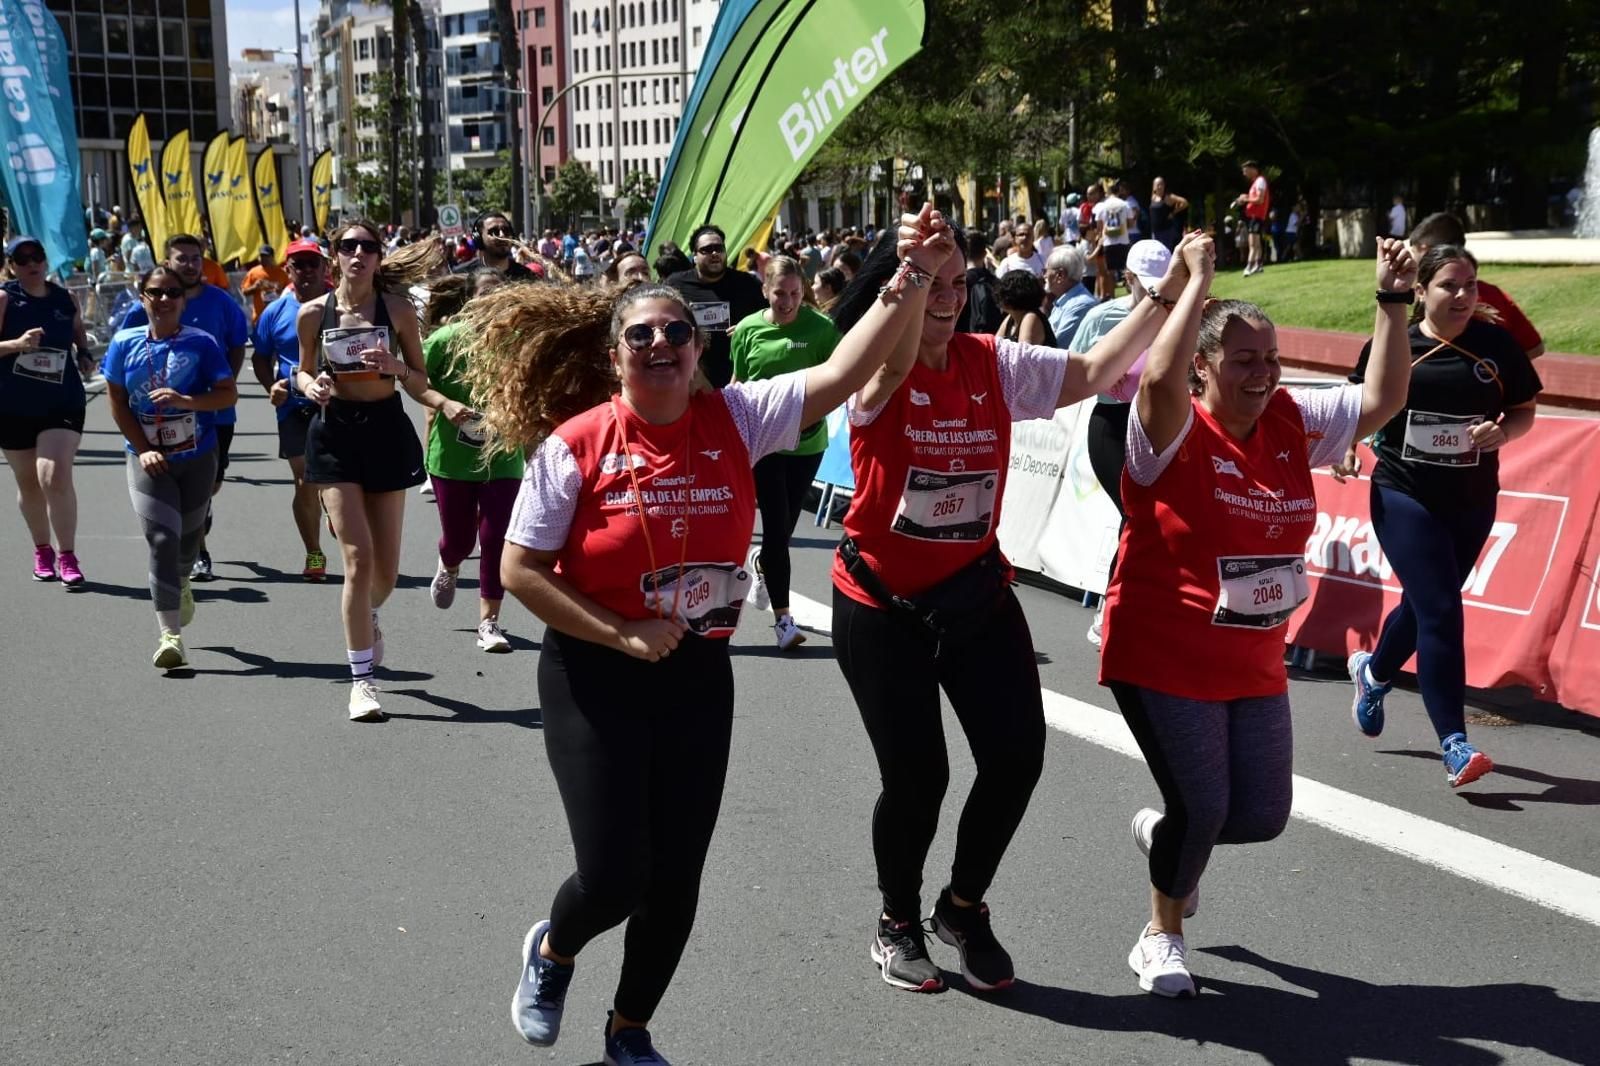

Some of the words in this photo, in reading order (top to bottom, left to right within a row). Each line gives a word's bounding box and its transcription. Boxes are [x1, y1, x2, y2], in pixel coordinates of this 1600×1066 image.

[777, 26, 889, 162] Binter
[904, 424, 938, 444] CRRERA
[949, 431, 964, 444] LAS
[1431, 434, 1459, 448] 2843
[1023, 454, 1060, 478] Deporte
[652, 474, 696, 487] Canaria7
[605, 490, 657, 505] CARRRA
[657, 490, 671, 504] DE
[690, 486, 734, 503] EMPRES
[1214, 487, 1255, 510] CARRERA
[1253, 499, 1265, 512] DE
[1264, 500, 1282, 513] LAS
[932, 497, 965, 518] 2057
[684, 581, 710, 610] 2049
[1252, 583, 1284, 606] 2048
